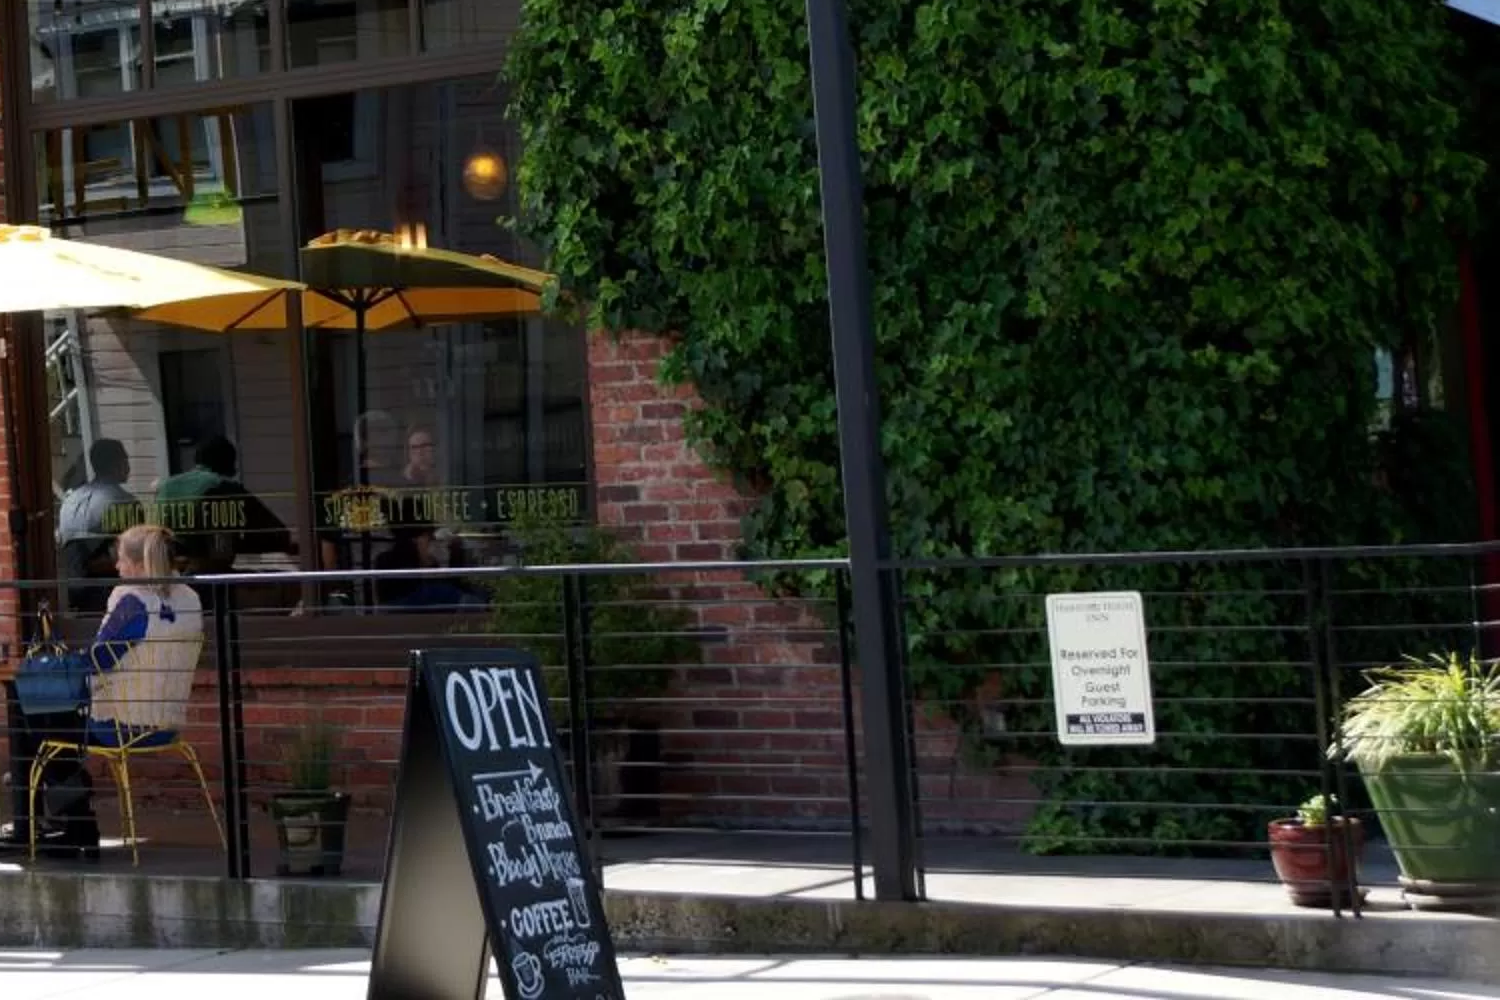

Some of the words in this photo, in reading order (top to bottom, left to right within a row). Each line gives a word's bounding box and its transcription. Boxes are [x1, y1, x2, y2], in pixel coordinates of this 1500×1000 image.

[201, 501, 246, 528] FOODS
[323, 493, 405, 525] SPELTY
[413, 491, 469, 521] COFFEE
[497, 487, 578, 520] ESPRESSO
[1060, 648, 1117, 660] Reserved
[1120, 648, 1138, 659] For
[1071, 664, 1131, 679] Overnight
[1085, 681, 1121, 693] Guest
[445, 667, 551, 751] OPEN
[1081, 695, 1127, 709] Parking
[511, 898, 574, 937] COFFEE
